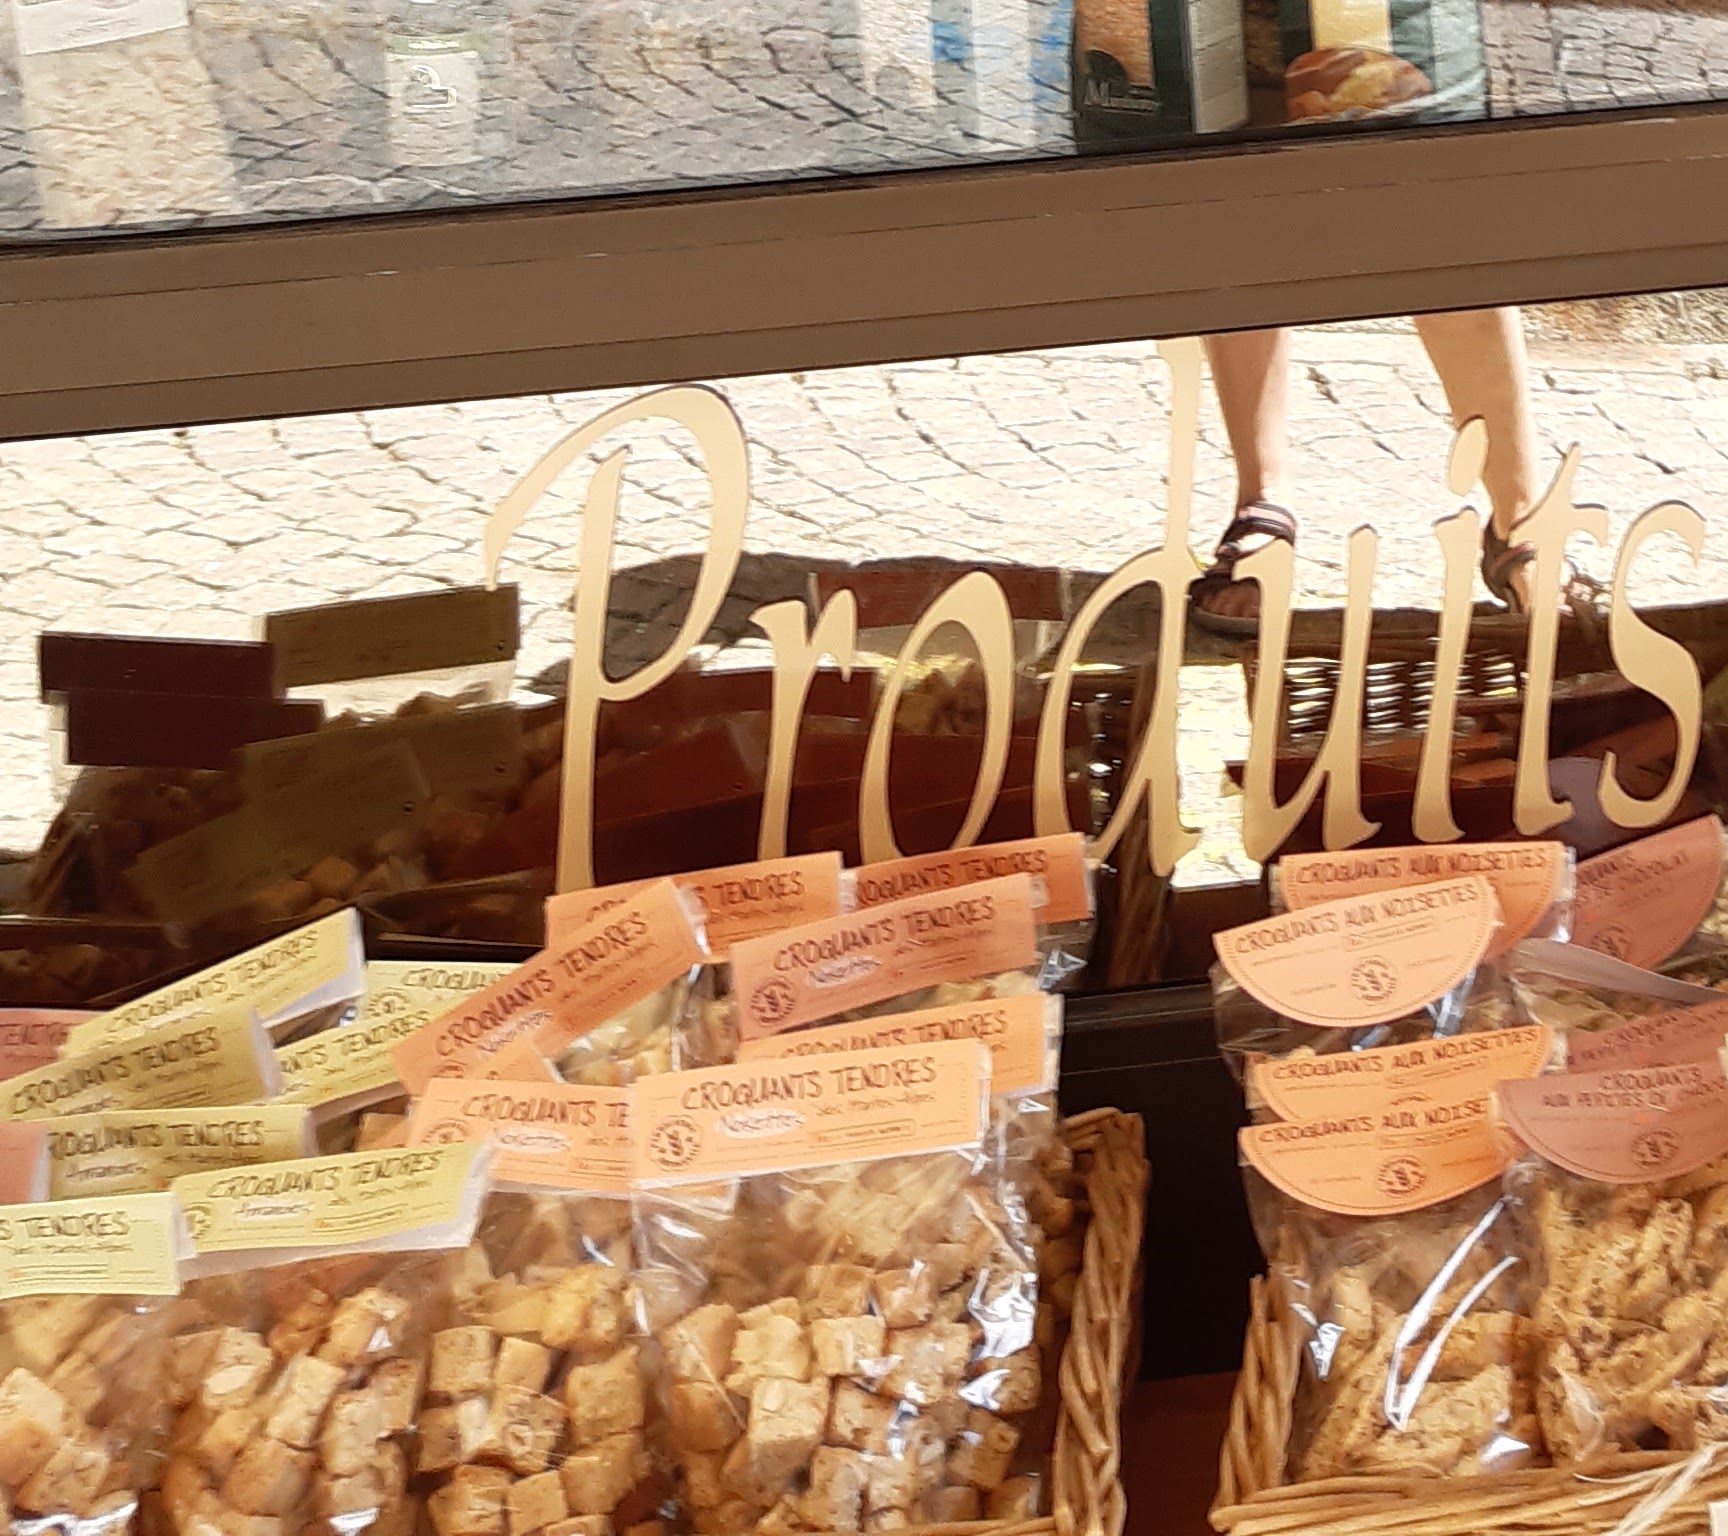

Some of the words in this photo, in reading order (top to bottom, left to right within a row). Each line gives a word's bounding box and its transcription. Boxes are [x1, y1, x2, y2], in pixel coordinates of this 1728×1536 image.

[484, 332, 1708, 894] Produits
[708, 869, 806, 907] TENDRES
[959, 848, 1050, 882] TENDRES
[1296, 856, 1402, 884] CROQUANTS
[1407, 854, 1444, 876] AUX
[1448, 847, 1547, 874] NOISETTES
[771, 917, 898, 973] CROQUANTS
[899, 894, 998, 939] TENDRES
[1234, 911, 1339, 954] CROQUANTS
[1343, 904, 1377, 927] AUX
[1379, 883, 1481, 921] NOISETTES
[112, 971, 229, 1030] CROQUANTS
[232, 927, 321, 980] TENDRES
[433, 968, 559, 1057] CROQUANTS
[558, 910, 650, 978] TENDRES
[331, 1008, 432, 1057] TENDRES
[1271, 1054, 1386, 1080] CROQUANTS
[1390, 1048, 1428, 1069] AUX
[1431, 1028, 1539, 1059] NOISETTES
[12, 1054, 131, 1116] CROQUANTS
[131, 1025, 222, 1073] TENDRES
[681, 1069, 824, 1112] CROQUANTS
[829, 1056, 938, 1096] TENDRES
[168, 1120, 267, 1149] TENDRES
[461, 1093, 598, 1129] CROQUANTS
[1257, 1115, 1376, 1144] CROQUANTS
[1380, 1109, 1418, 1129] AUX
[206, 1166, 342, 1200] CROQUANTS
[350, 1149, 446, 1185] TENDRES
[21, 1209, 132, 1240] TENDRES
